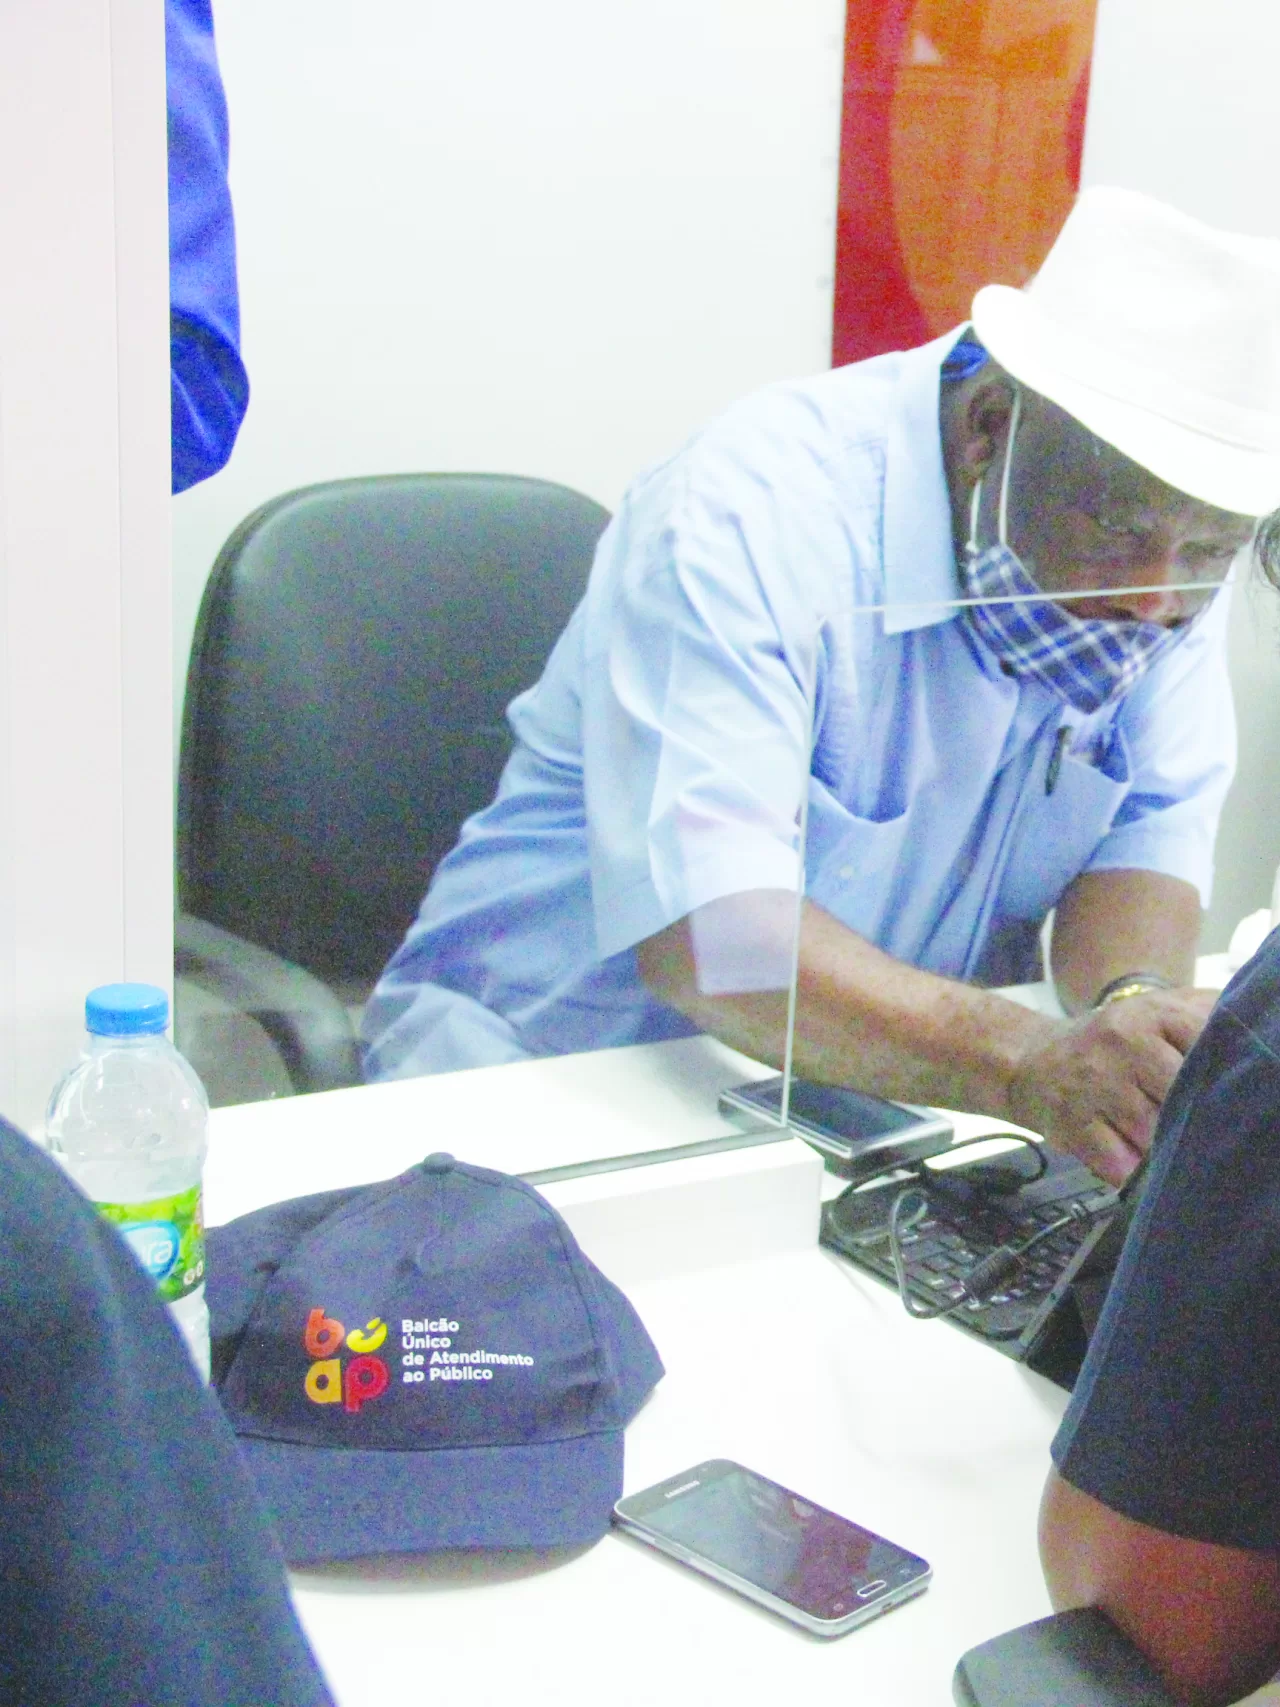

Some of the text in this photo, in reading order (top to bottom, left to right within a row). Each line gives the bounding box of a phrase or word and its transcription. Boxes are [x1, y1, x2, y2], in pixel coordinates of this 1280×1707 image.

[401, 1318, 460, 1333] Balcão
[402, 1333, 451, 1349] Único
[402, 1350, 535, 1366] de Atendimento
[403, 1366, 493, 1383] ao Público
[304, 1354, 390, 1413] ap
